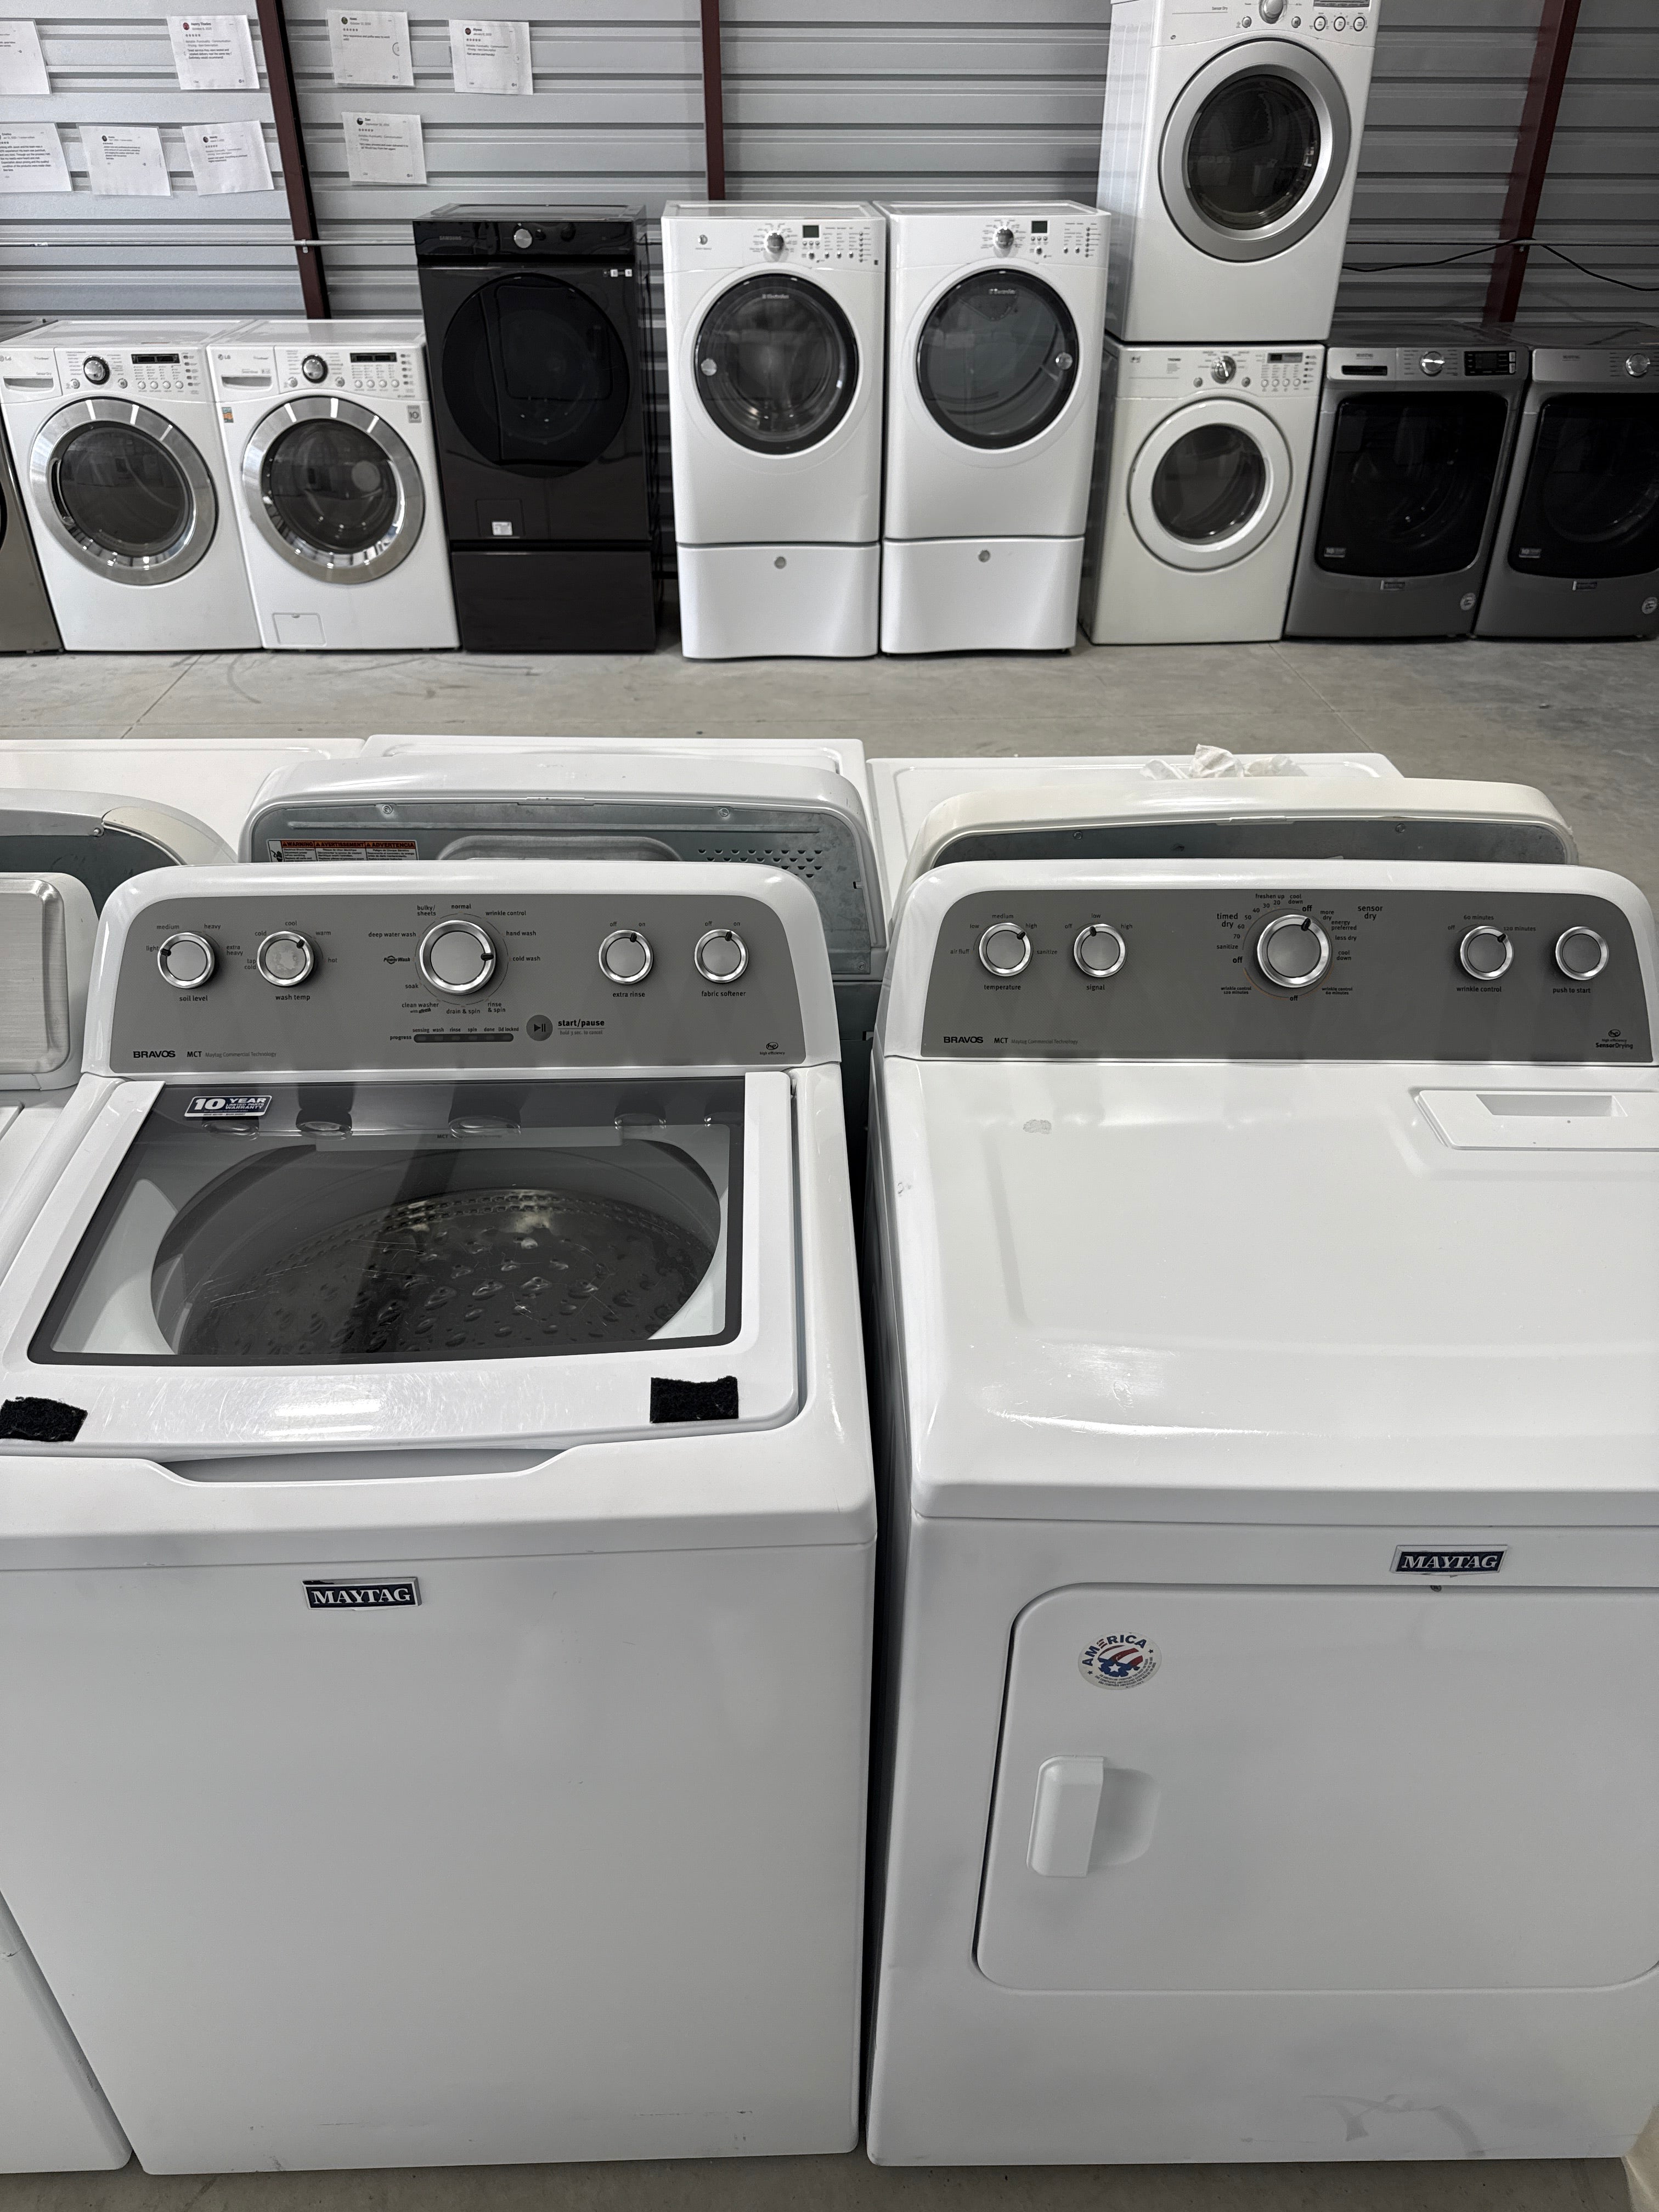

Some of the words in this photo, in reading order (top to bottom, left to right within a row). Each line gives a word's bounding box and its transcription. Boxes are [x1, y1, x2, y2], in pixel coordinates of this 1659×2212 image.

[1364, 912, 1376, 921] dry
[1222, 921, 1233, 929] dry
[558, 1019, 605, 1028] start/pause
[194, 1098, 225, 1110] 10
[1401, 1555, 1498, 1568] MAYTAG
[311, 1588, 411, 1604] MAYTAG
[1082, 1634, 1147, 1666] AMERICA
